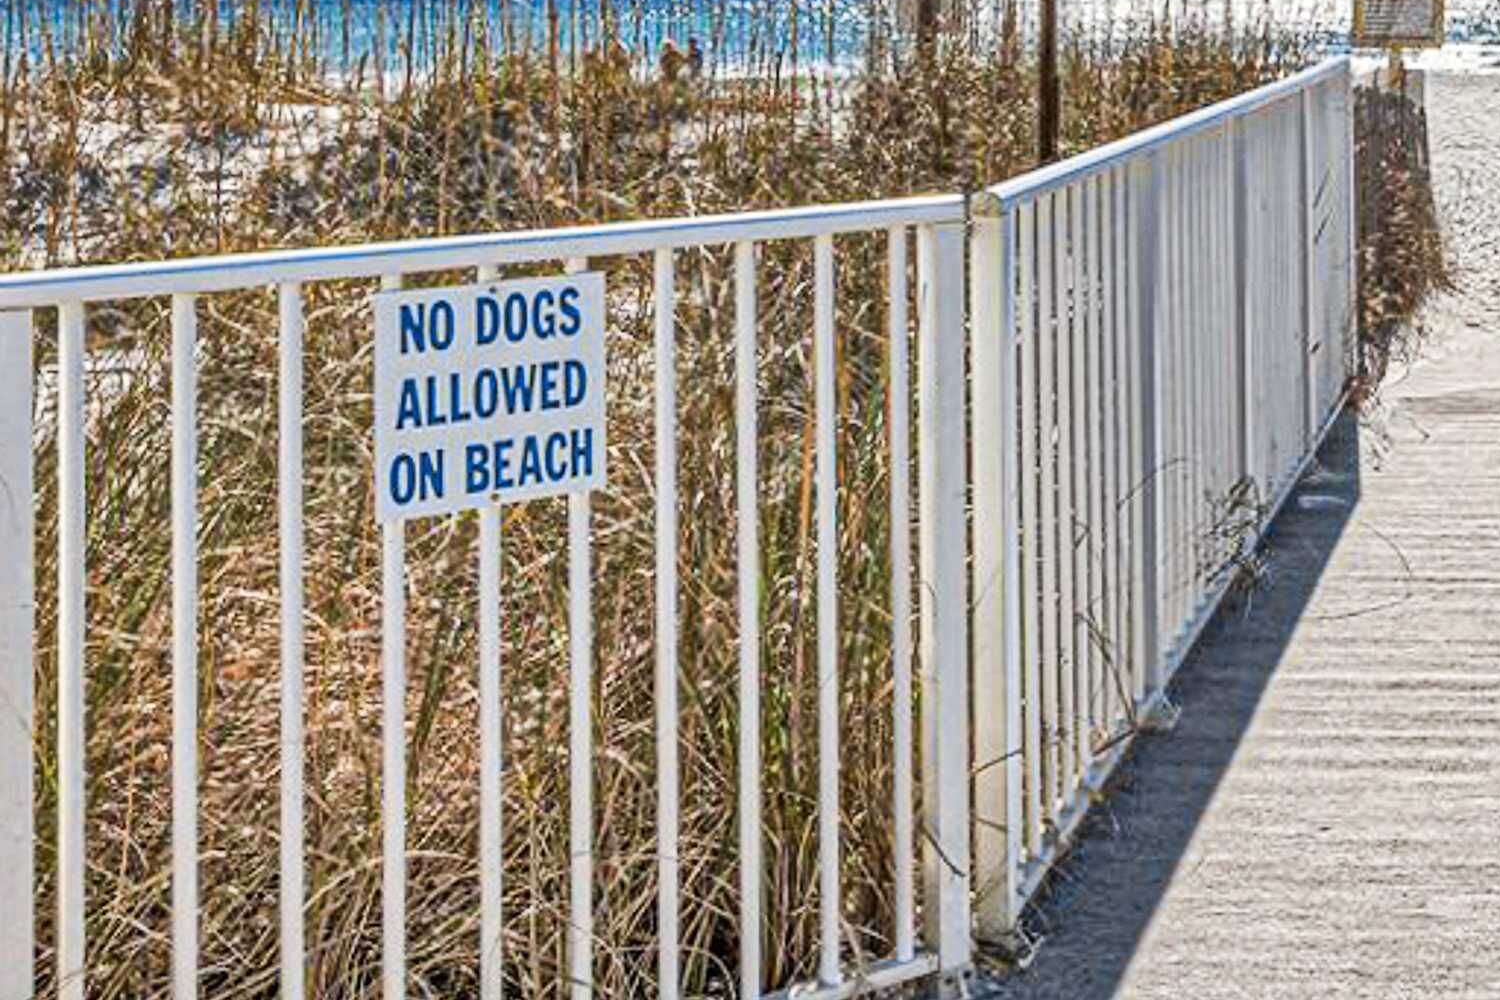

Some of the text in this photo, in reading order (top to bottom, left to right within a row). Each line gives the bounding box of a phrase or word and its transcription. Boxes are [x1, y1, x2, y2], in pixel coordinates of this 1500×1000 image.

[398, 287, 581, 354] NO DOGS
[395, 359, 587, 430] ALLOWED
[389, 427, 593, 506] ON BEACH
